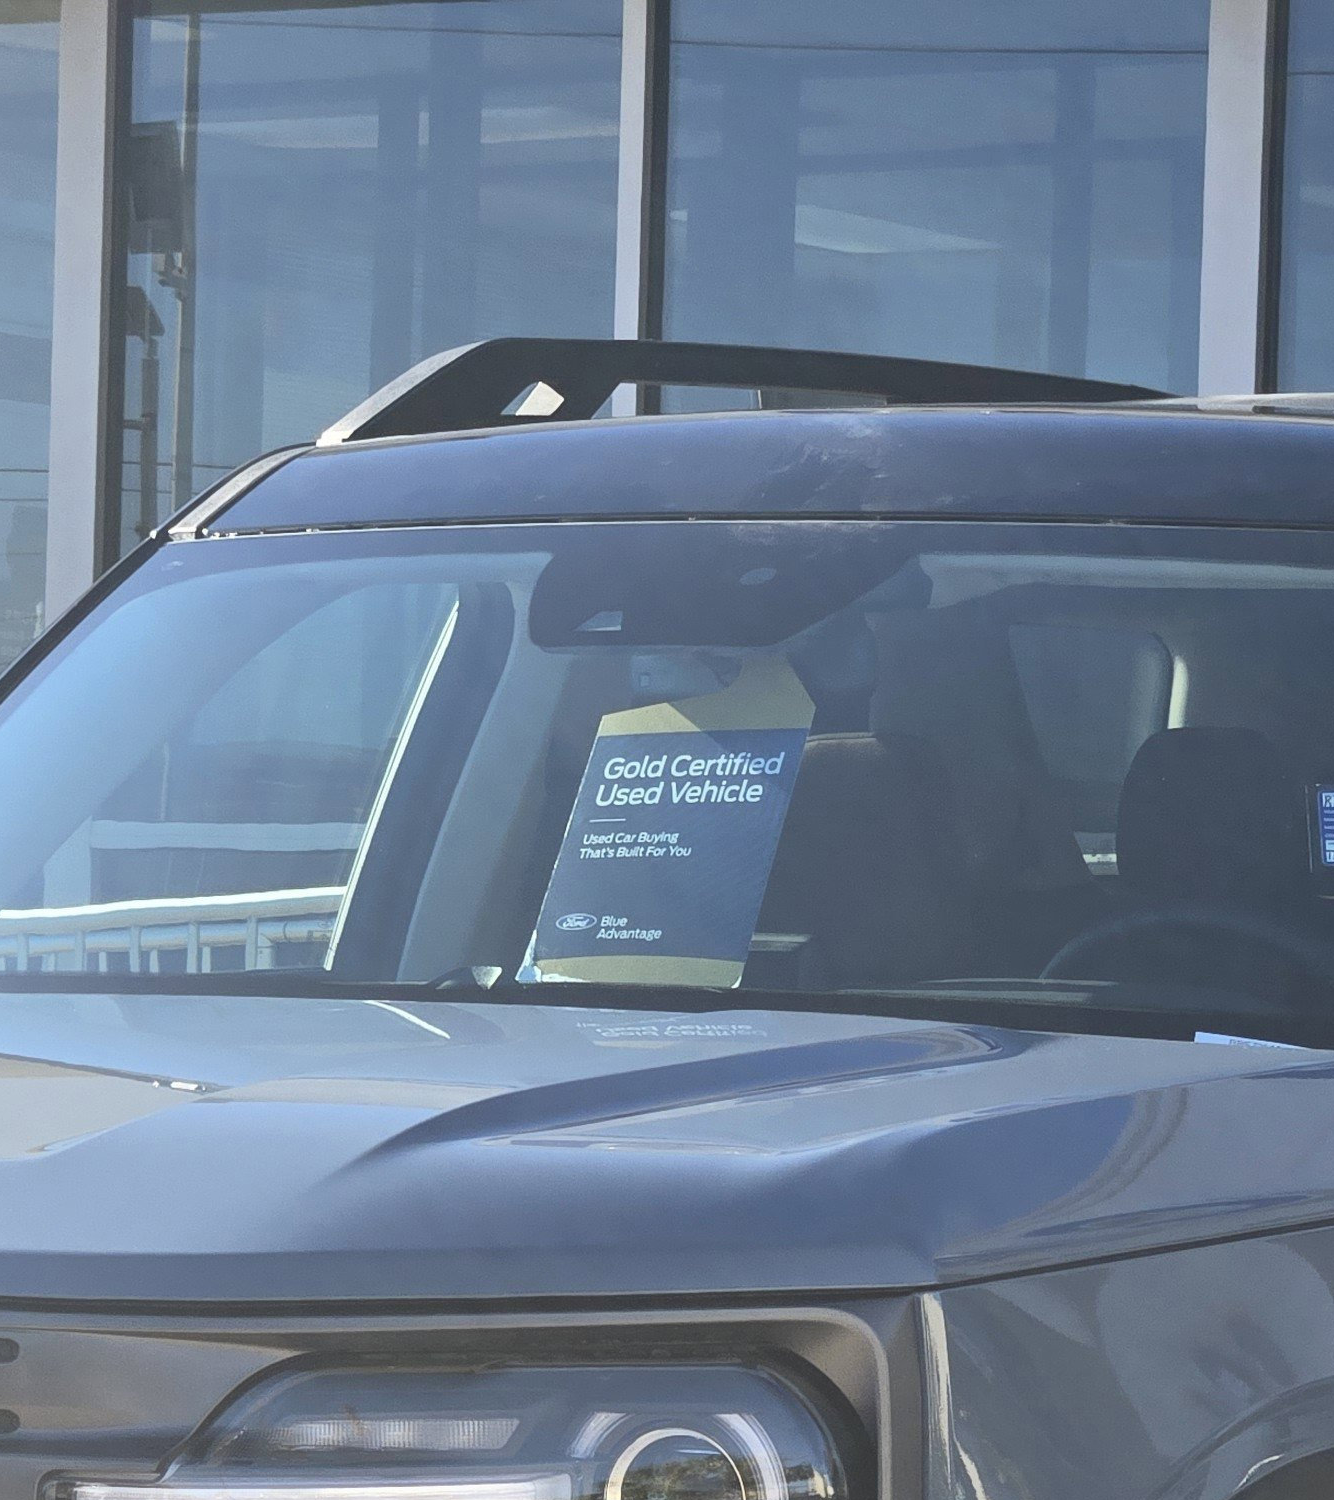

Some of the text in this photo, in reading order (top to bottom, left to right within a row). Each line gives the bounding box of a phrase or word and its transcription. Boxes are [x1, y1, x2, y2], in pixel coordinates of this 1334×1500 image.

[603, 751, 785, 780] Gold Certified
[596, 779, 763, 807] Used Vehicle
[583, 831, 680, 845] Used Car Buying
[579, 845, 692, 859] That's Built For You
[600, 915, 628, 927] Blue
[596, 928, 662, 941] Advantage
